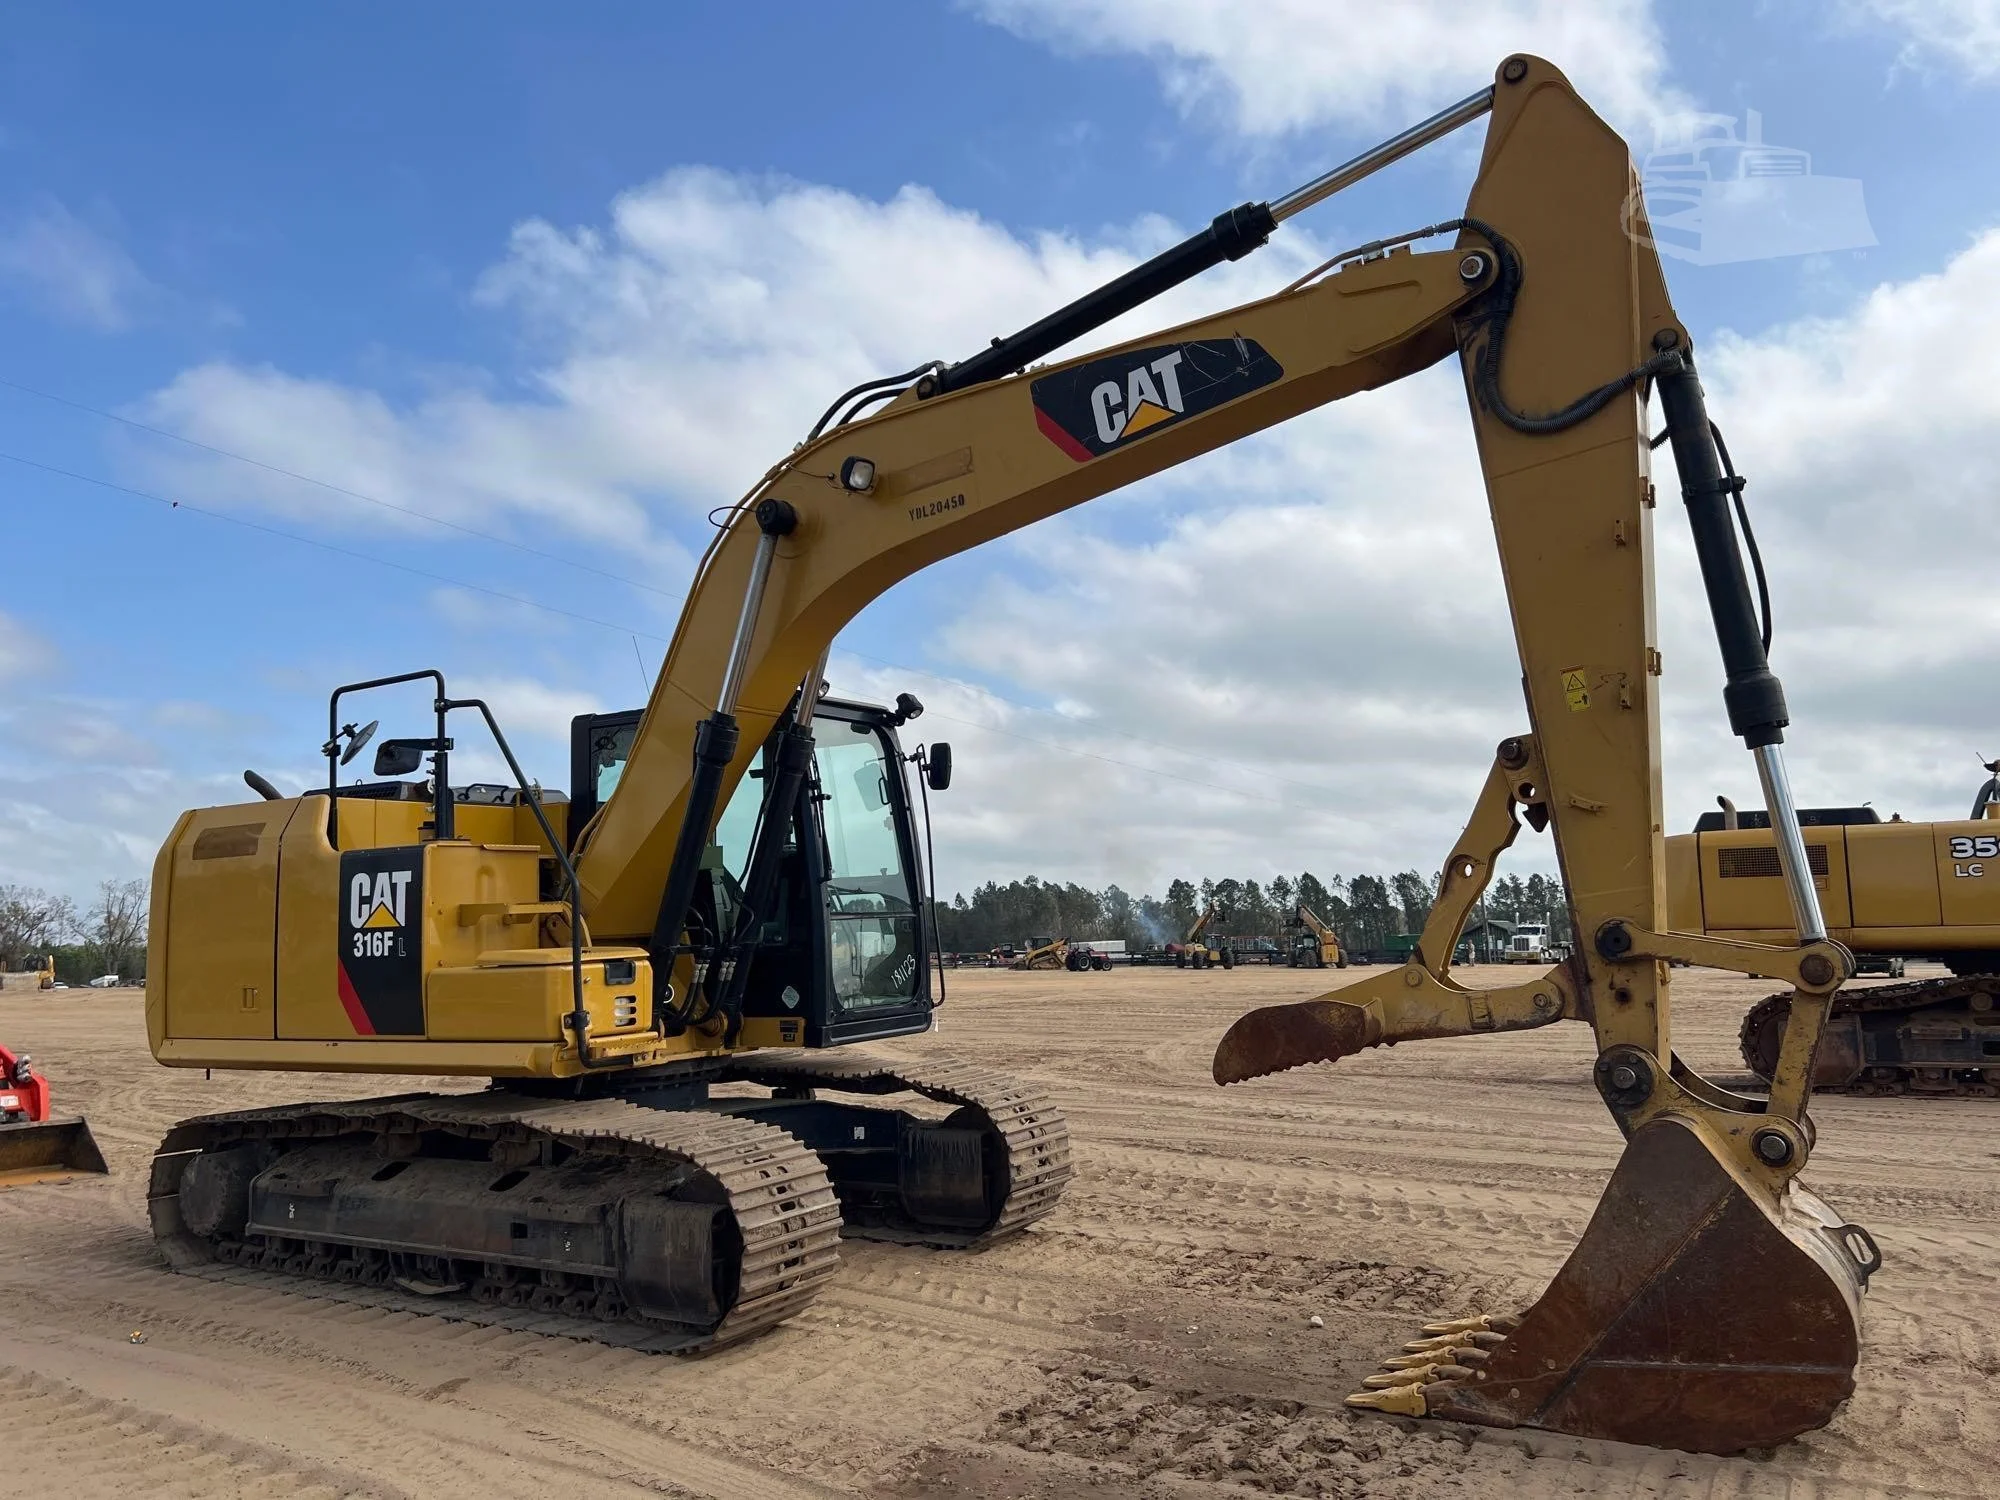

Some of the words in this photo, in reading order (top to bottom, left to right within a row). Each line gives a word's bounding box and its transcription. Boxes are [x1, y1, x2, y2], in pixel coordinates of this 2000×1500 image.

[1091, 350, 1185, 443] CAT
[1949, 836, 2000, 859] 35
[1954, 863, 1984, 878] LC
[350, 870, 412, 929] CAT
[353, 931, 394, 958] 316F
